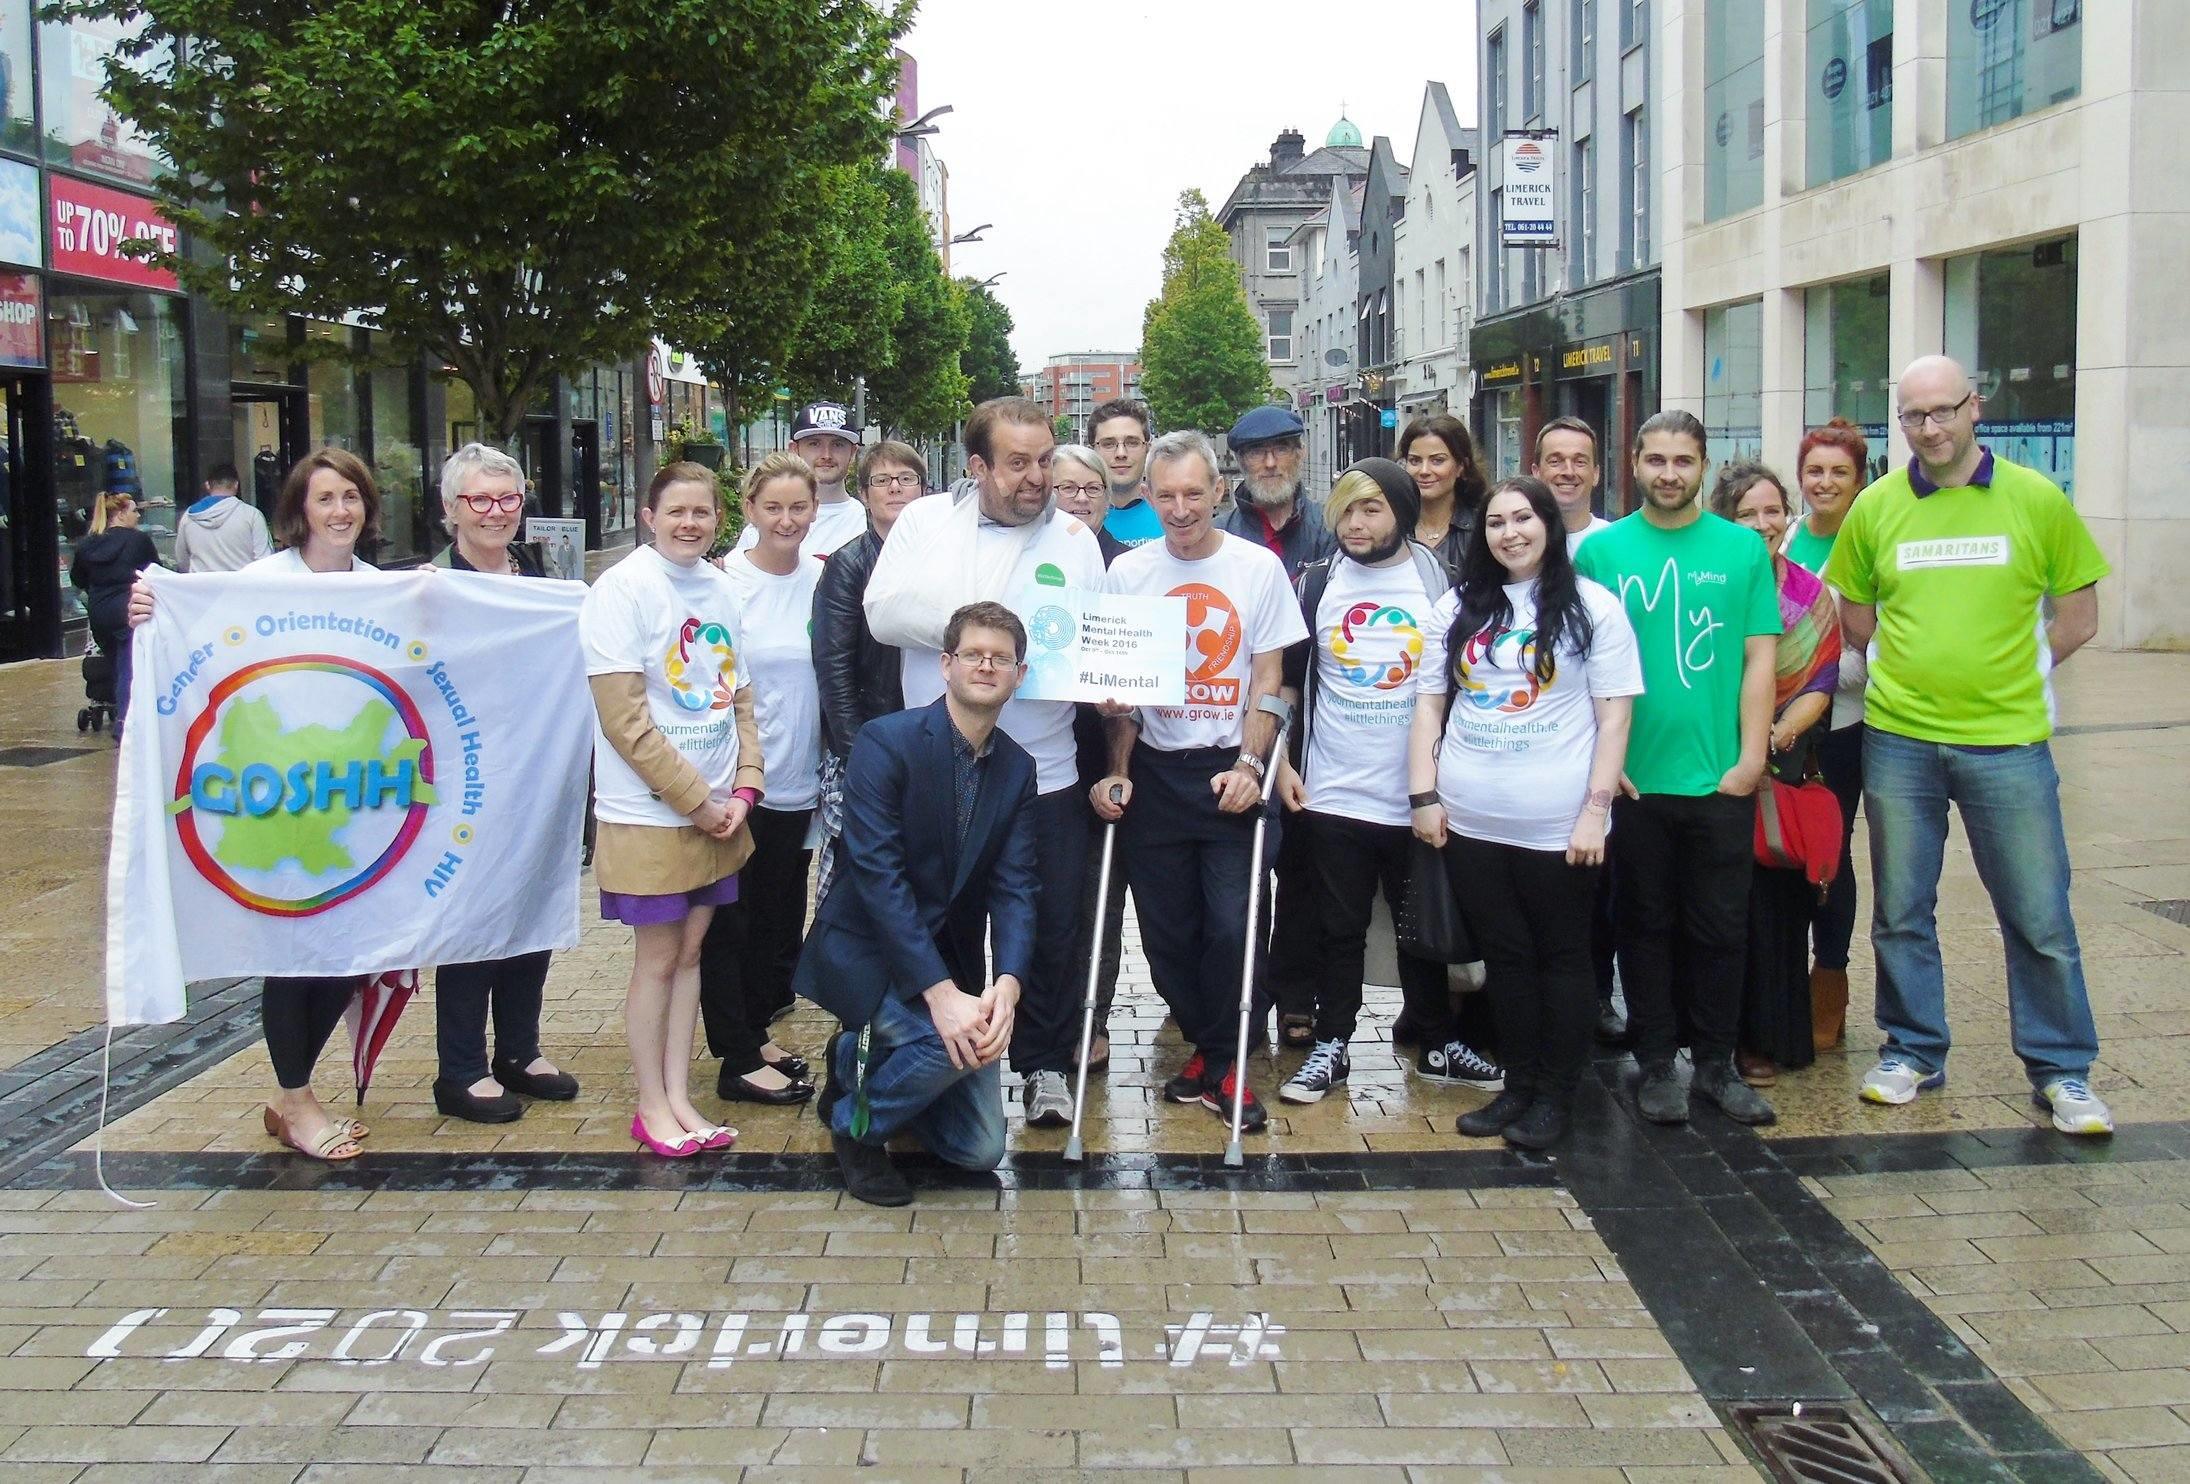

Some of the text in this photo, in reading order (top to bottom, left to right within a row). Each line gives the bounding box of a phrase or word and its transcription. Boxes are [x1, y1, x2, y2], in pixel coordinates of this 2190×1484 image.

[1505, 184, 1551, 193] LIMERICK
[57, 200, 76, 223] UP
[1511, 197, 1545, 206] TRAVEL
[57, 226, 75, 251] TO
[75, 205, 130, 260] 70%
[1562, 345, 1611, 368] LIMERICK TRAVEL
[809, 406, 847, 426] VANS
[1903, 541, 1999, 560] SAMARITANS
[1082, 612, 1127, 625] Limerick
[255, 610, 400, 651] Orientation
[1081, 635, 1138, 649] Week 2016
[1082, 624, 1153, 638] Mental Health
[1207, 625, 1236, 673] FRIENDSHIP
[1079, 671, 1160, 689] #LiMental
[425, 660, 477, 728] Sexual
[461, 731, 486, 816] Health
[190, 759, 414, 815] GOSHH
[424, 851, 465, 899] HIV
